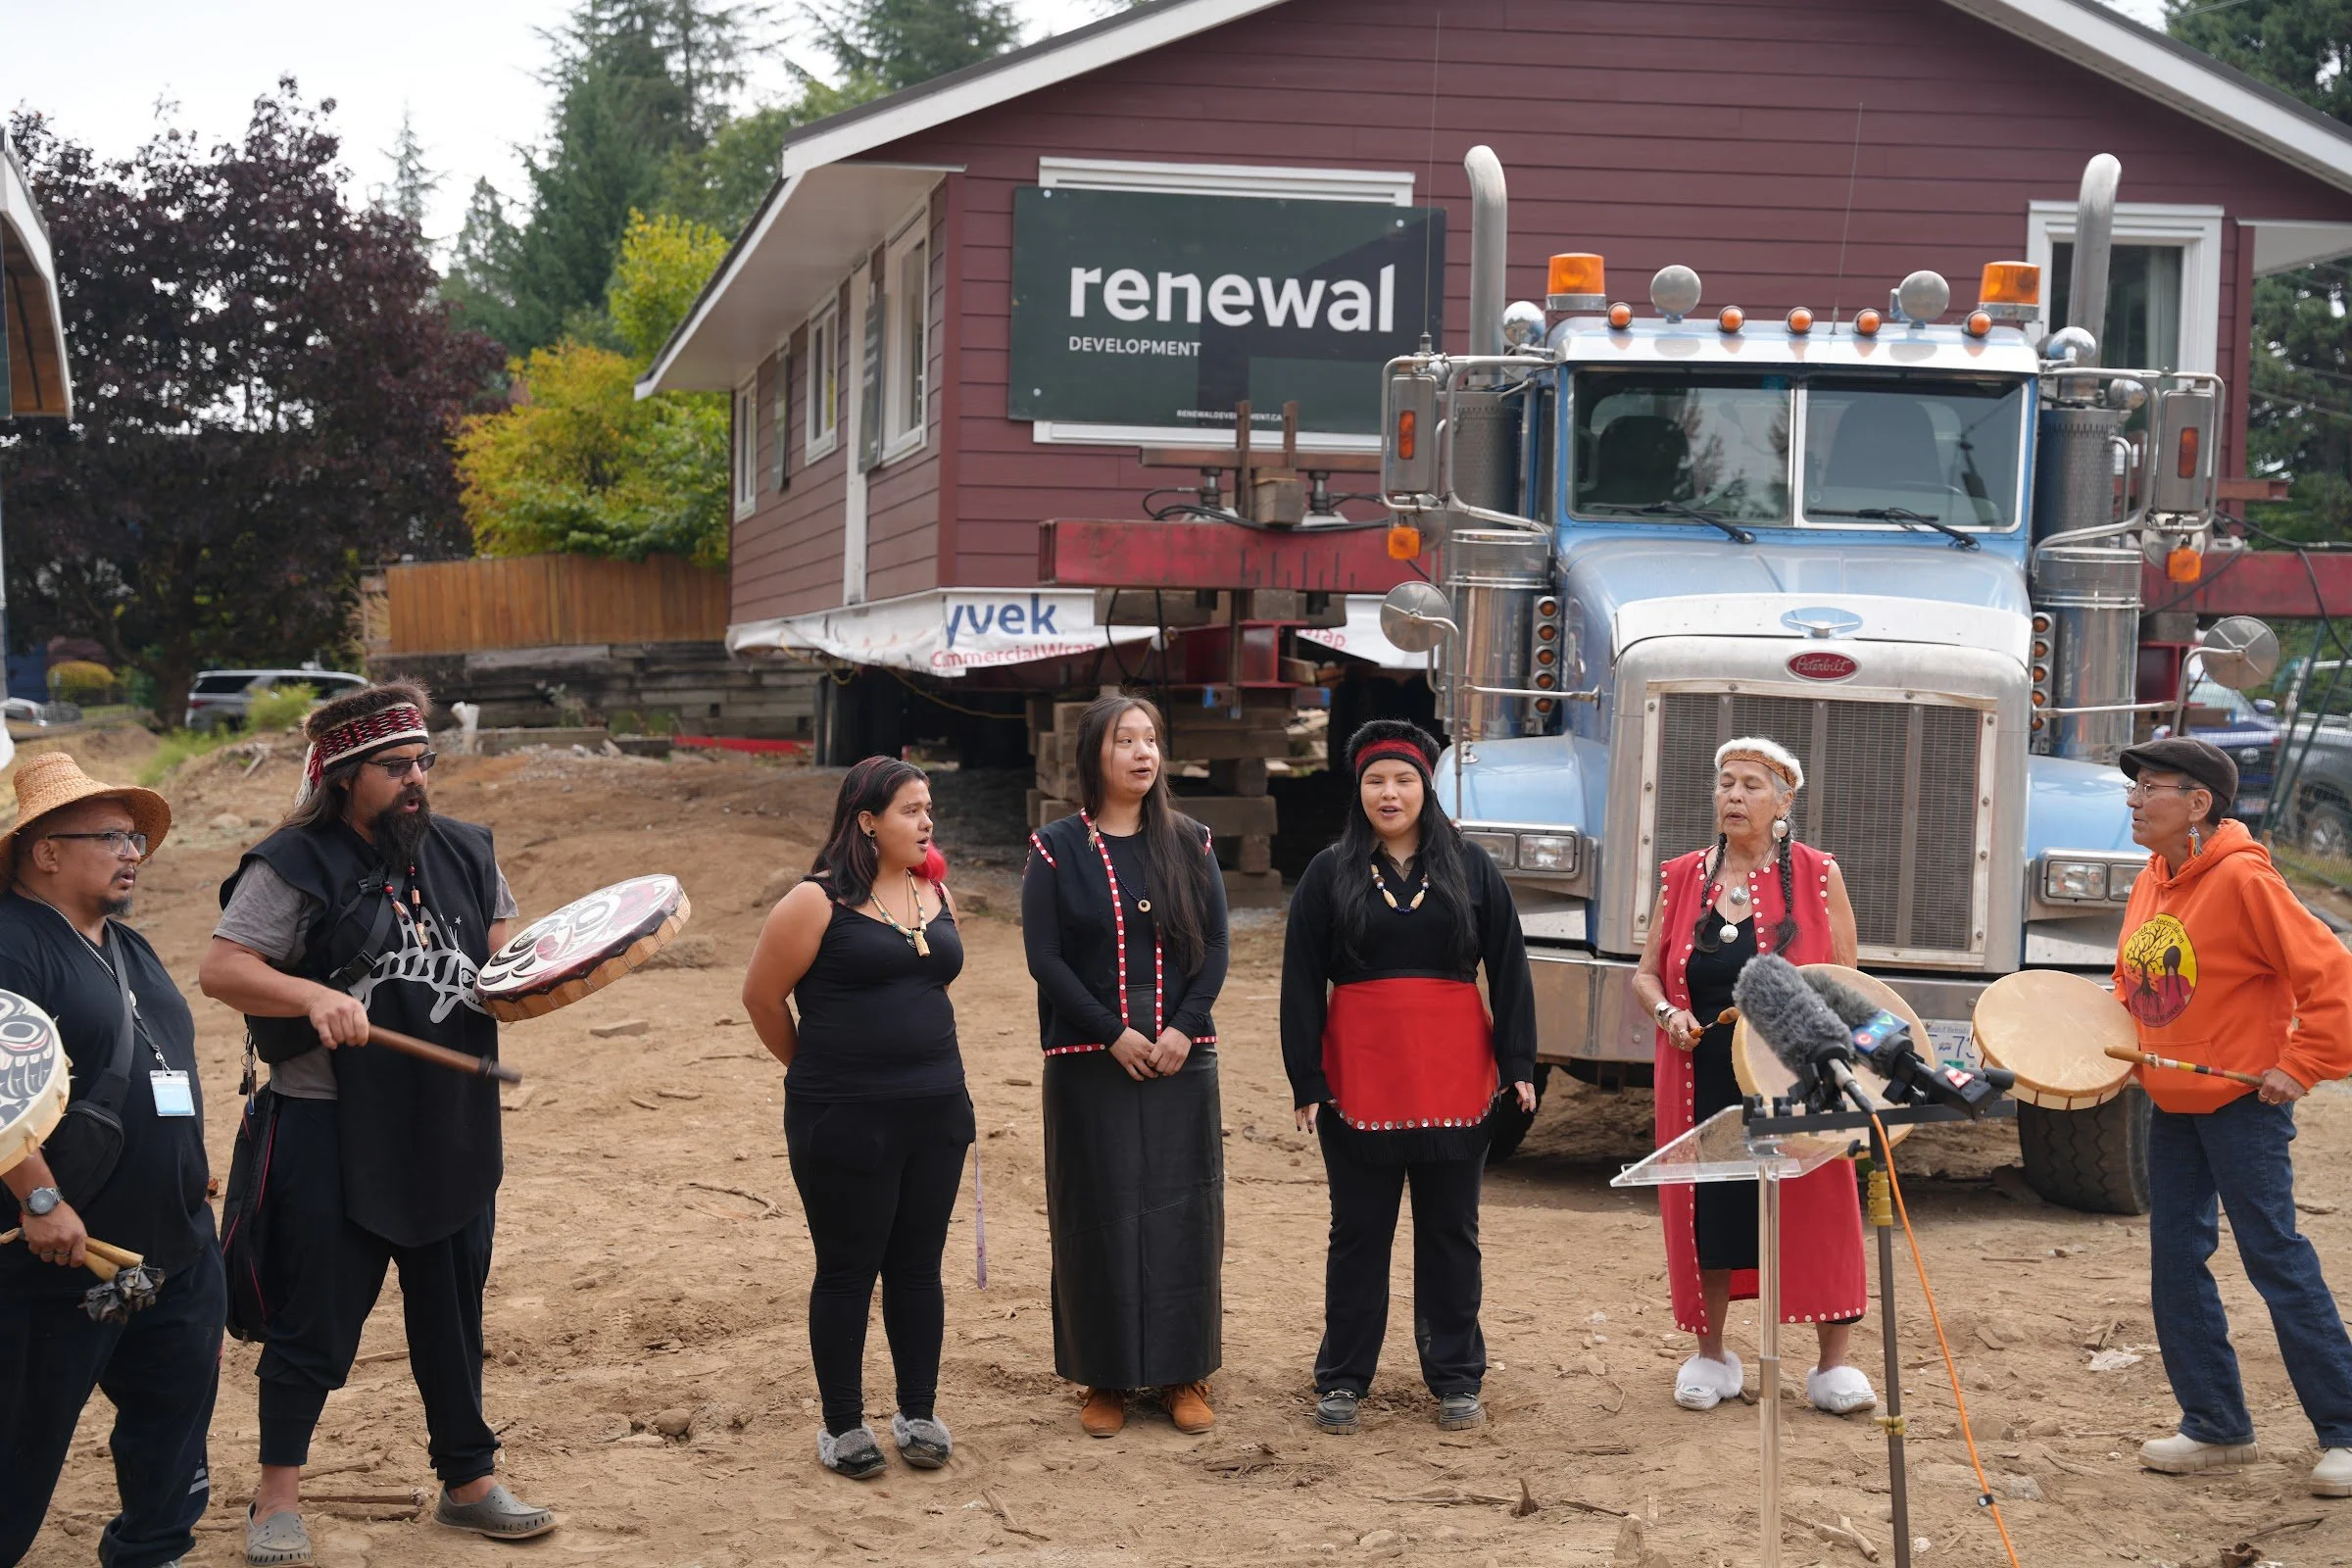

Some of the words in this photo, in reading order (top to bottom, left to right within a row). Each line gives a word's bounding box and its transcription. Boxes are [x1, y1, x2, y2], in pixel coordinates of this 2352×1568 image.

[1069, 264, 1396, 332] renewal
[1068, 336, 1201, 357] DEVELOPMENT
[1795, 656, 1851, 672] Peterbilt
